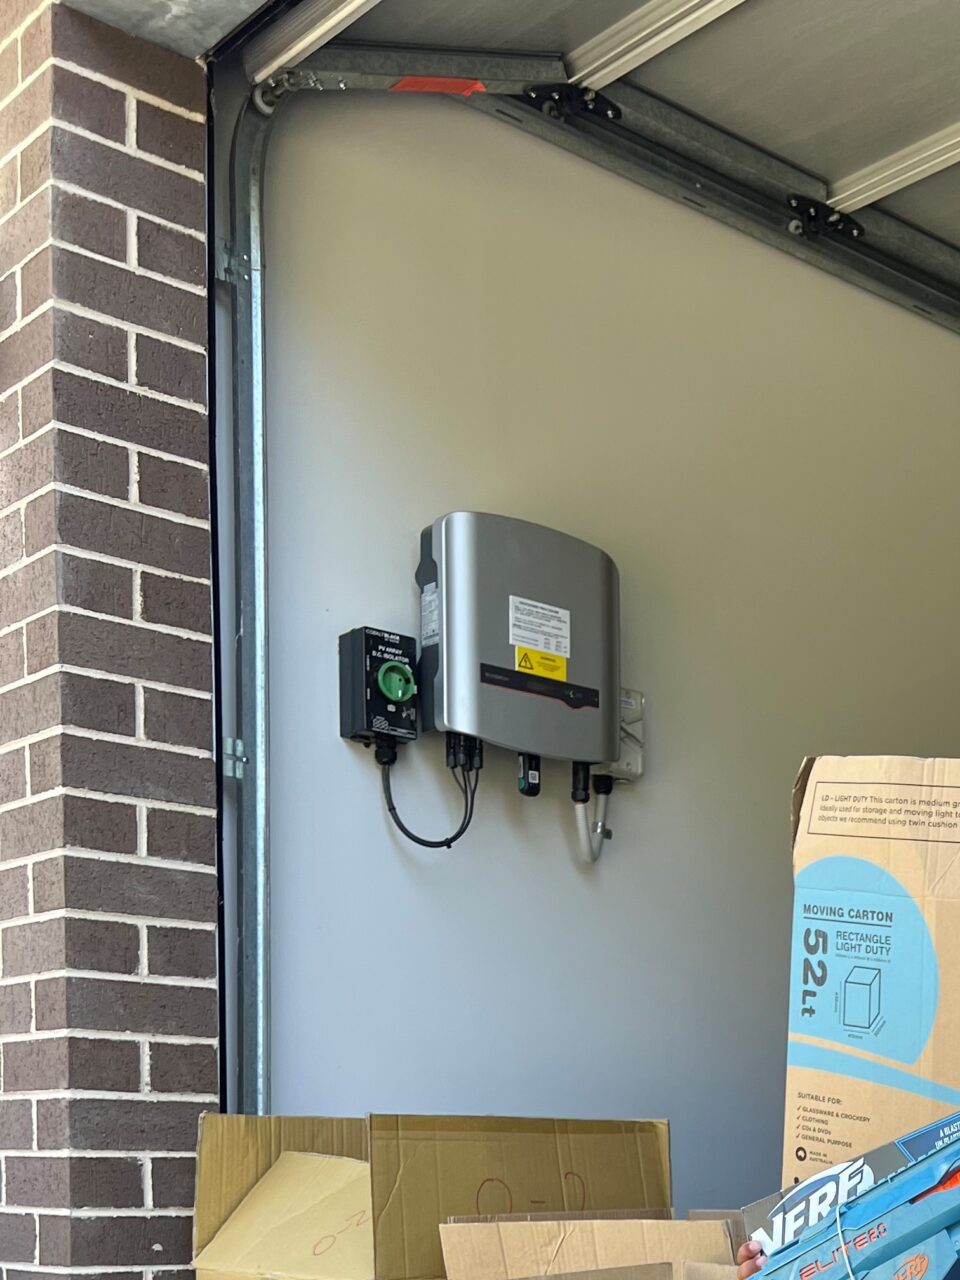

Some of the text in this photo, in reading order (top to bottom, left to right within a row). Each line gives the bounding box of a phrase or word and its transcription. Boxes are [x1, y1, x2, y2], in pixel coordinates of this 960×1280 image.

[869, 795, 883, 804] This
[884, 797, 909, 805] carton
[918, 799, 951, 807] medium
[862, 807, 888, 816] storage
[889, 807, 902, 815] and
[903, 809, 933, 818] moving
[935, 810, 953, 819] light
[848, 817, 887, 825] recommend
[888, 819, 907, 827] using
[927, 820, 958, 828] cushion
[803, 903, 894, 923] MOVING CARTON
[836, 930, 892, 946] RECTANGLE
[835, 941, 892, 957] LIGHT DUTY
[797, 1091, 843, 1106] SUITABLE FOR:
[801, 1115, 829, 1126] CLOTHING
[802, 1106, 871, 1123] GLASSWARE CROCKERY
[801, 1124, 832, 1136] CDs DVDs
[801, 1133, 853, 1149] GENERAL PURPOSE
[751, 1157, 865, 1257] NERF
